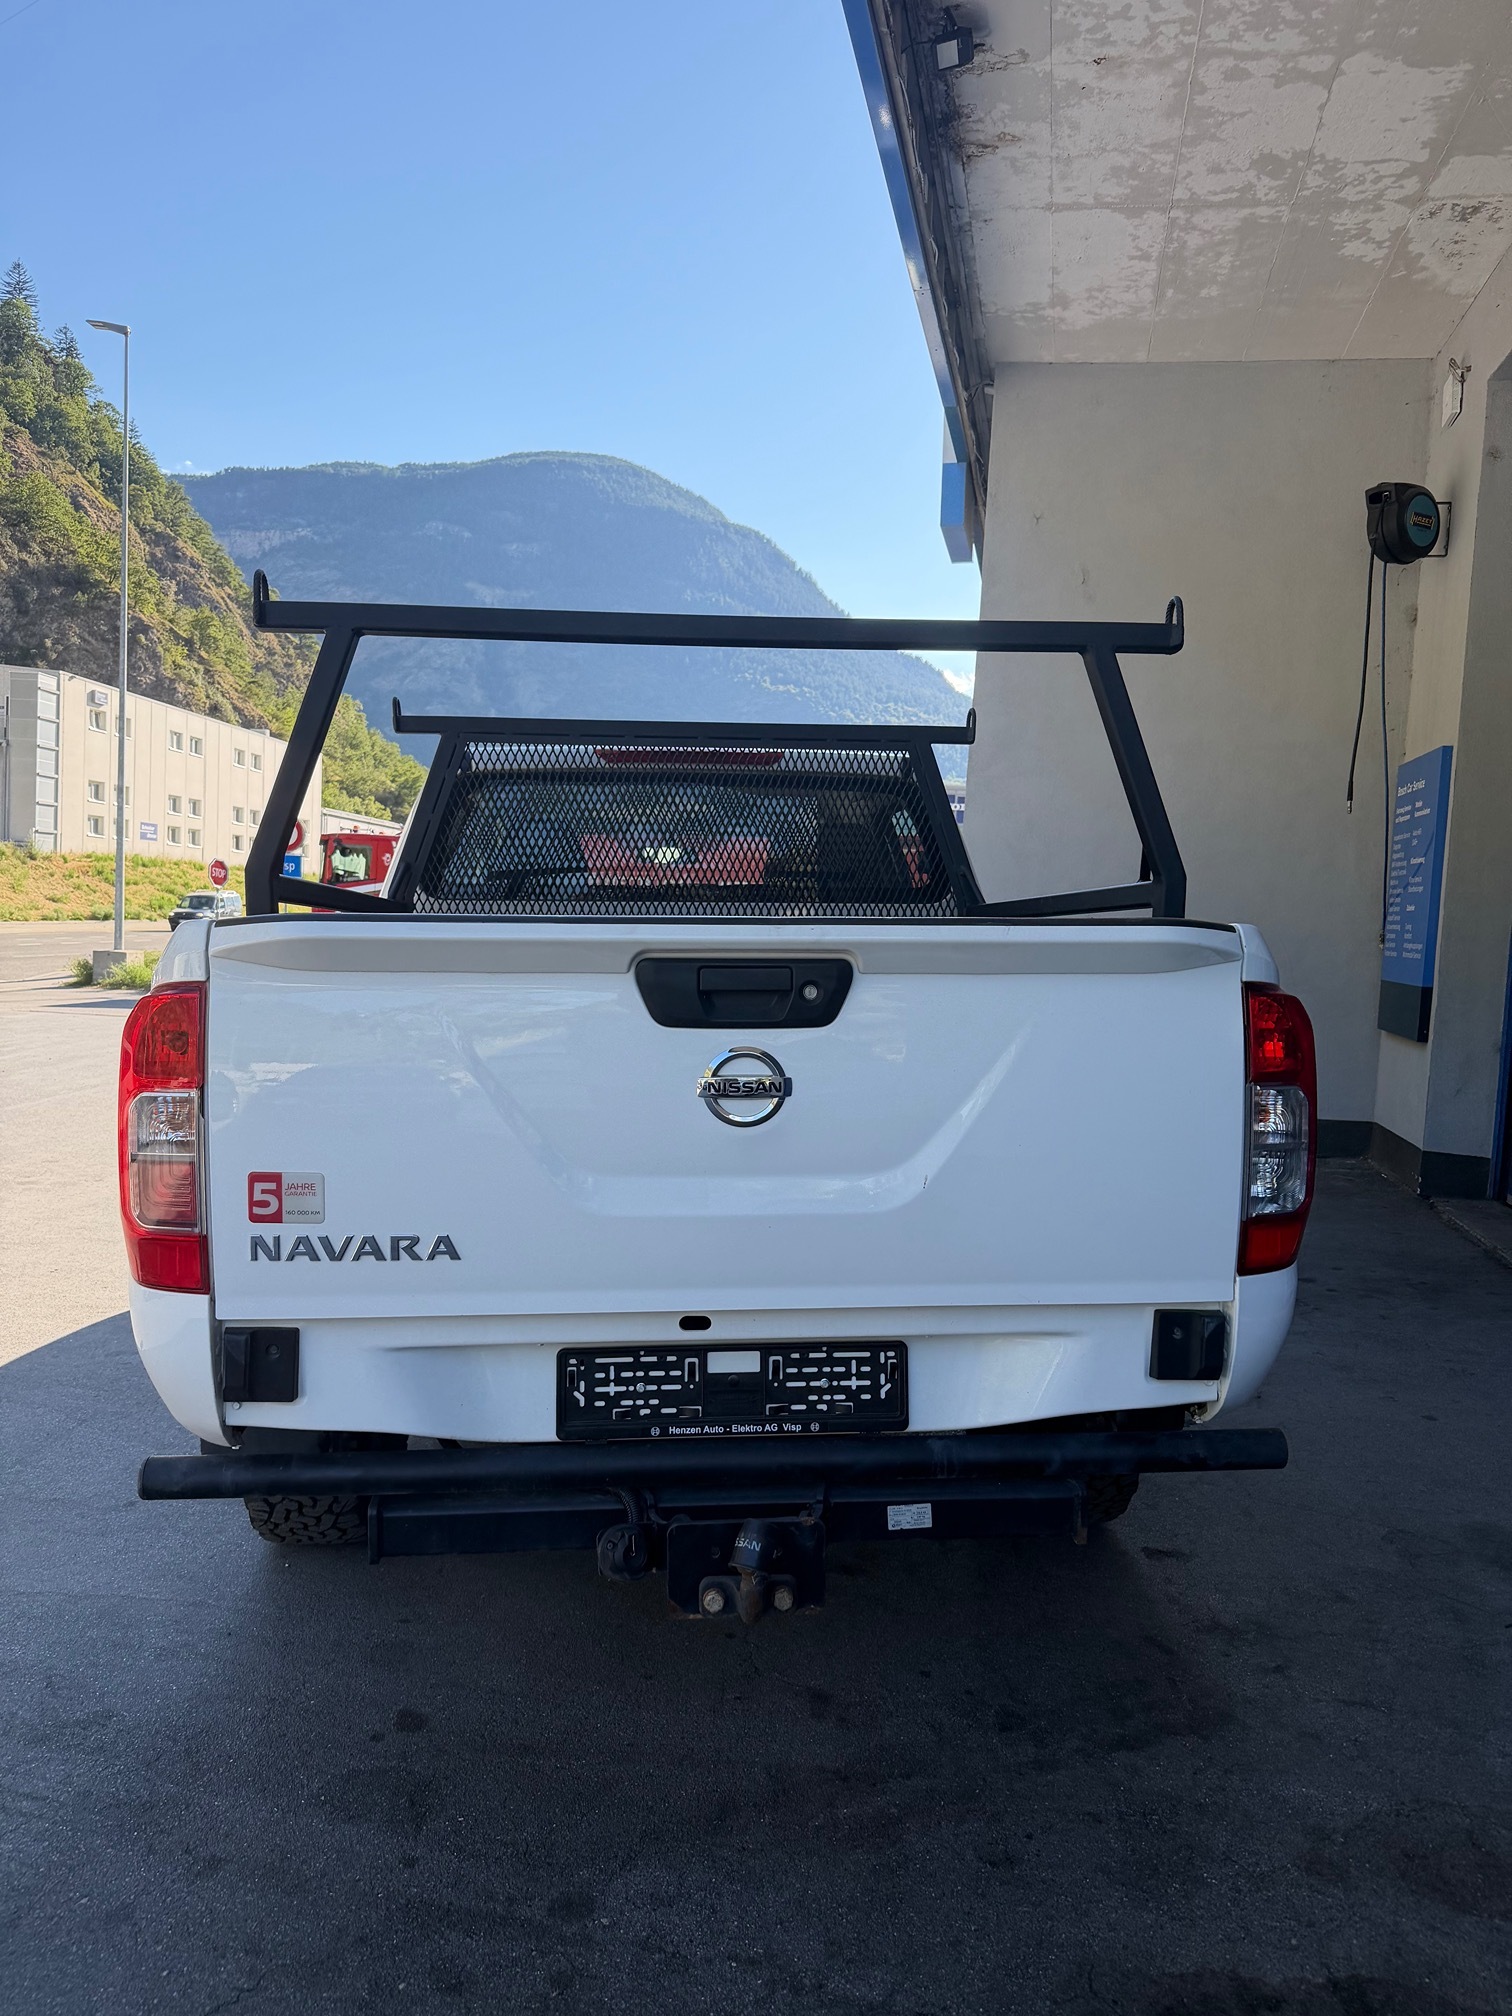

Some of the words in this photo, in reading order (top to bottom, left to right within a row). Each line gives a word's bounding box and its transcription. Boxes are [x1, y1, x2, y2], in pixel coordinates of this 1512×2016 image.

[1413, 515, 1432, 524] HAZET
[212, 867, 226, 878] STOP
[707, 1081, 782, 1094] NISSAN
[284, 1182, 316, 1191] JAHRE
[252, 1182, 280, 1215] 5
[250, 1234, 461, 1262] NAVARA
[669, 1425, 701, 1434] Henzen
[703, 1425, 724, 1434] Auto
[731, 1424, 762, 1433] Elektro
[764, 1423, 778, 1432] AG
[783, 1423, 801, 1433] Visp
